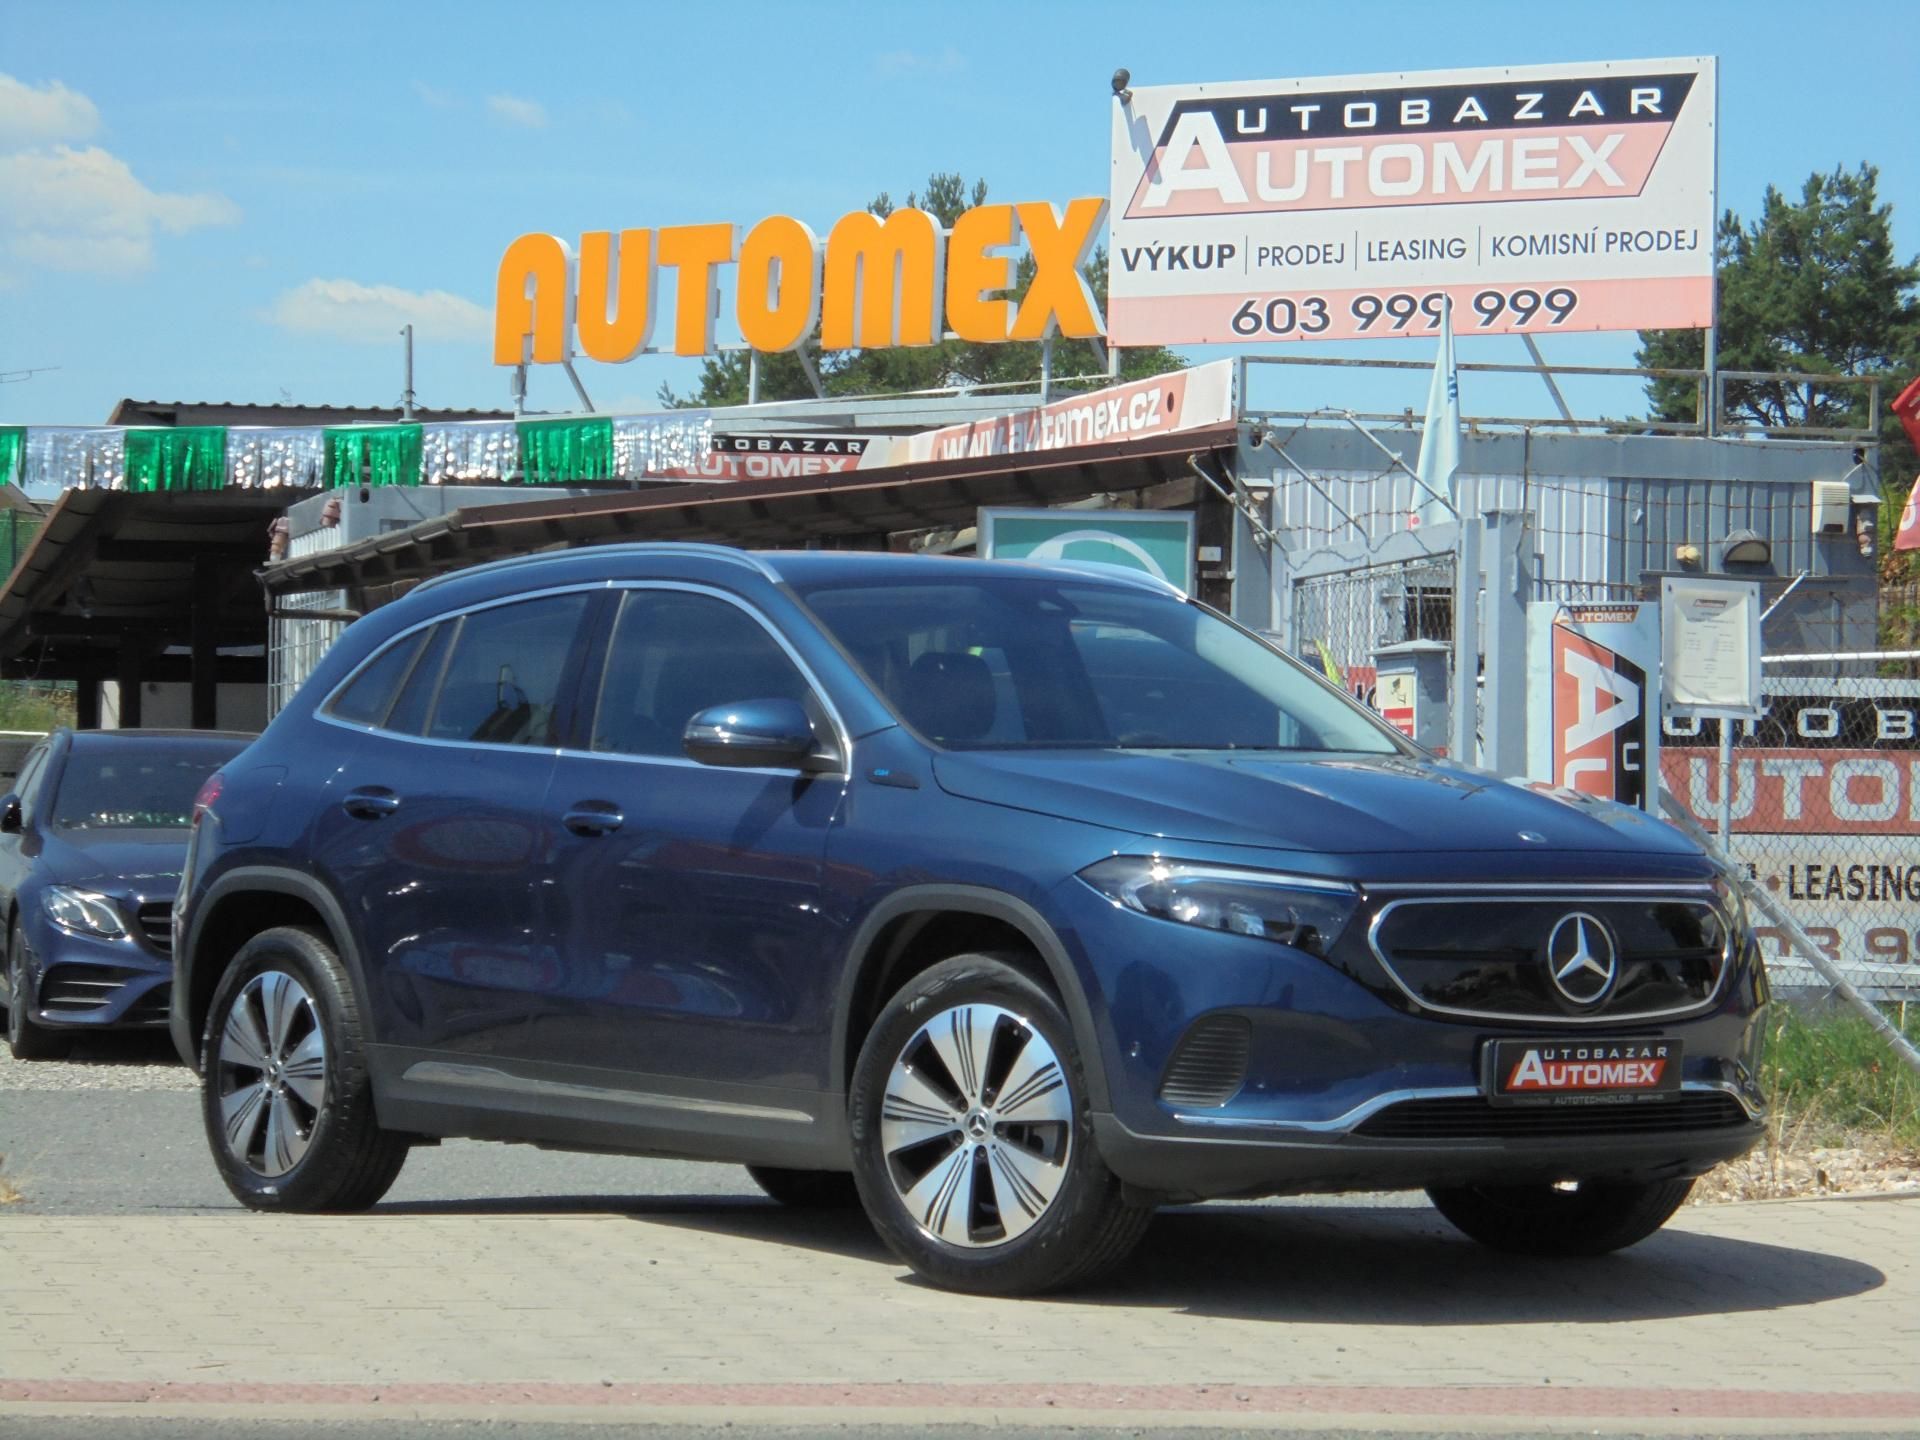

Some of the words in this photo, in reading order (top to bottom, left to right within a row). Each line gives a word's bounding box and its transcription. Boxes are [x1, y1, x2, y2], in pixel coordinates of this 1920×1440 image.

[1141, 110, 1626, 209] AUTOMEX
[1120, 240, 1236, 272] VÝKUP
[1257, 243, 1346, 268] PRODEJ
[1367, 237, 1467, 262] LEASING
[1491, 226, 1598, 258] KOMISNÍ
[1605, 229, 1699, 254] PRODEJ
[493, 196, 1109, 366] AUTOMEX
[1231, 297, 1332, 336] 603
[1351, 292, 1453, 332] 999
[1472, 287, 1580, 327] 999
[1555, 607, 1634, 623] AUTOMEX
[1658, 758, 1920, 822] UTO
[1788, 864, 1920, 900] LEASING
[1512, 1050, 1657, 1087] AUTOMEX
